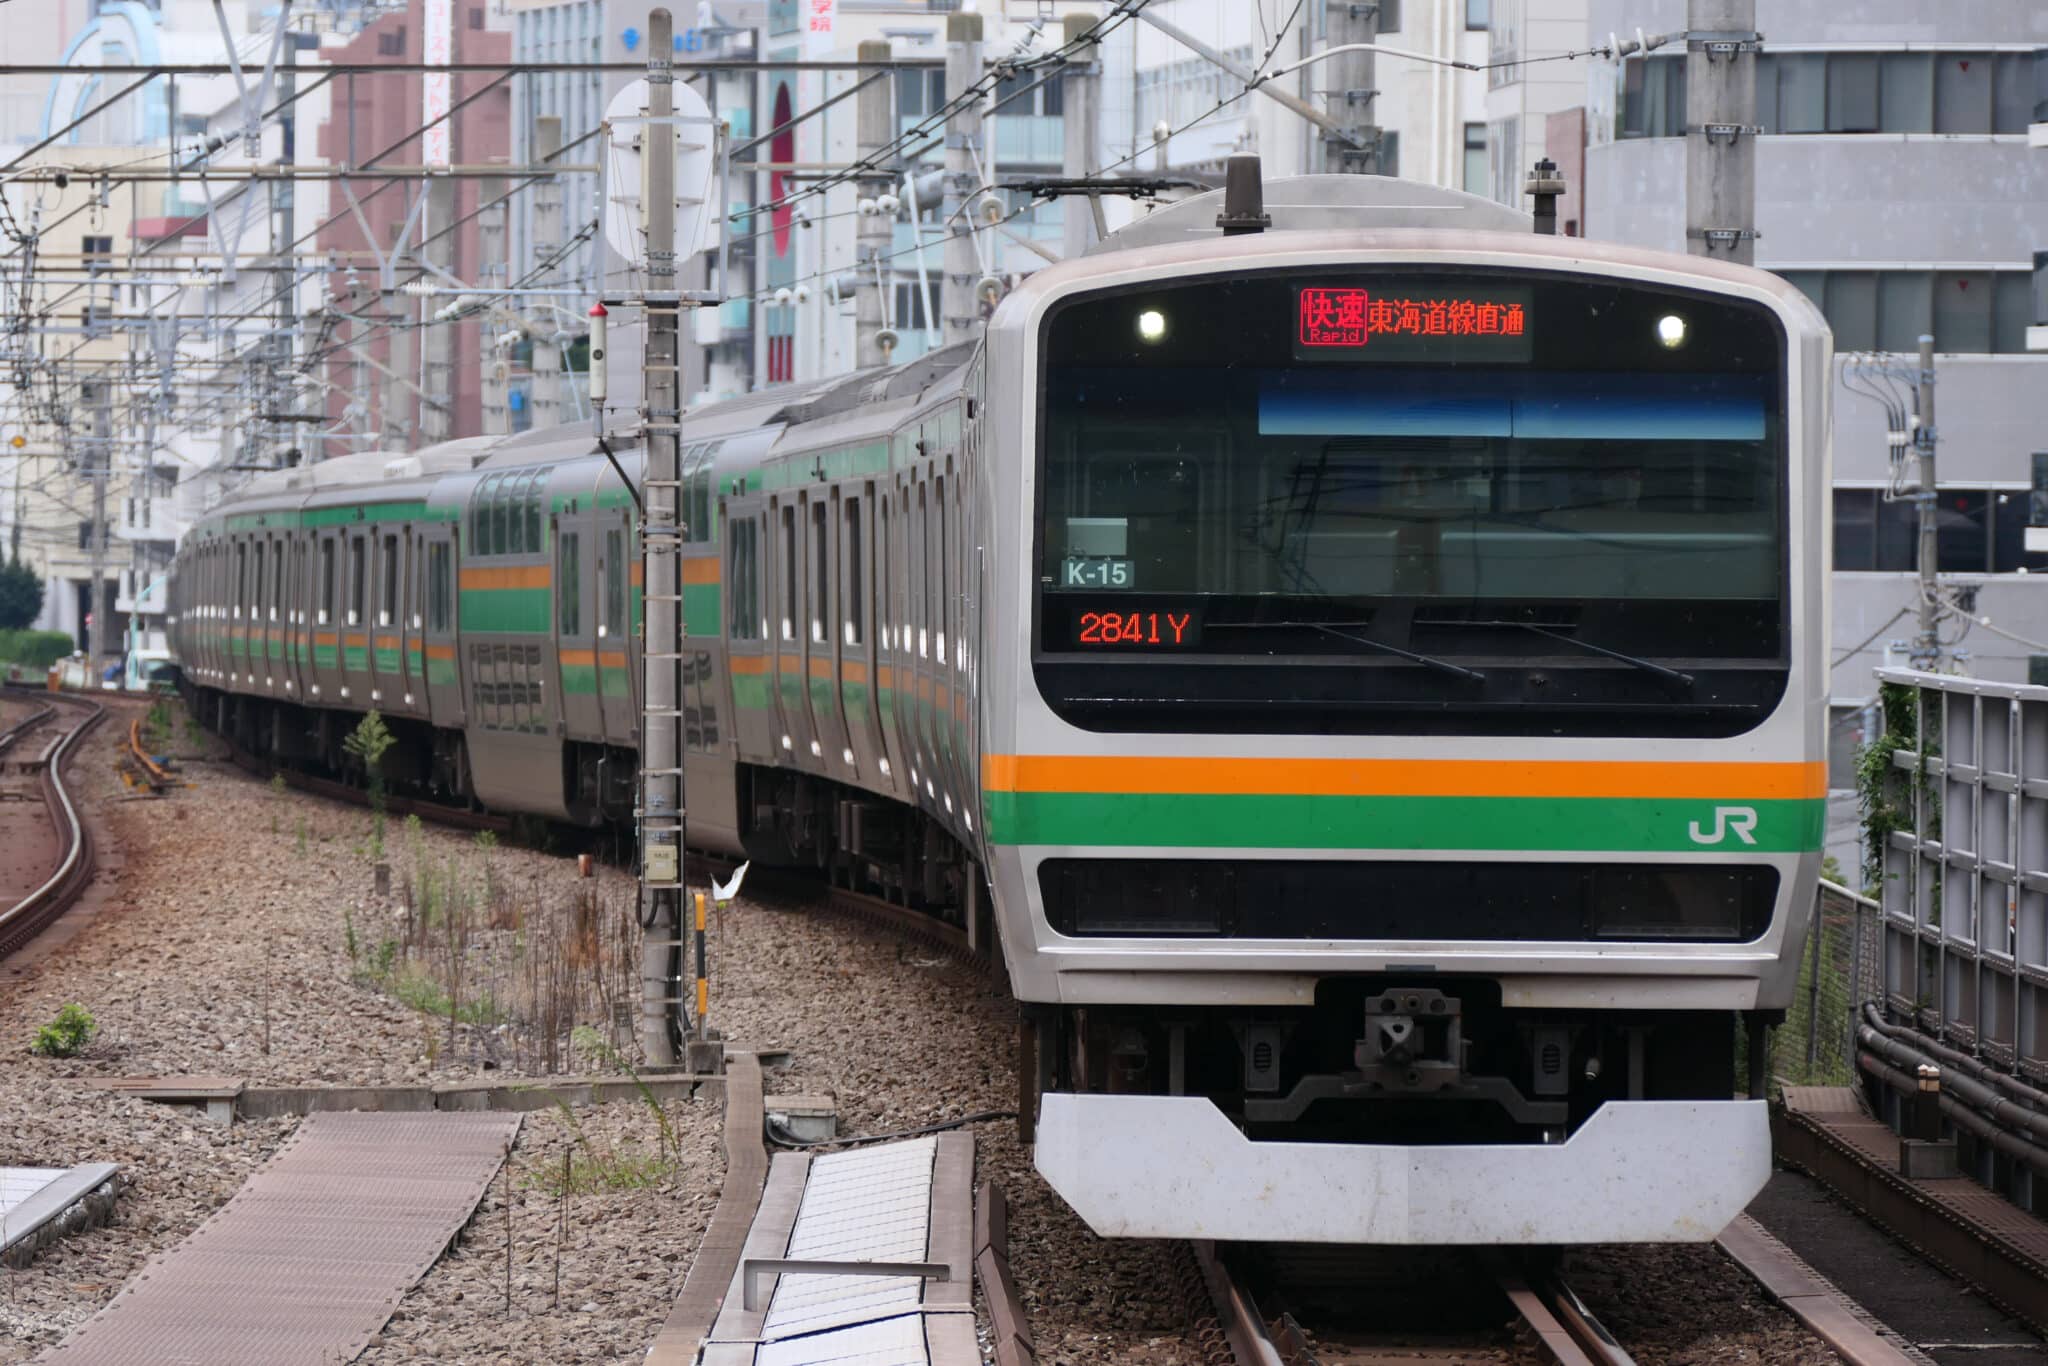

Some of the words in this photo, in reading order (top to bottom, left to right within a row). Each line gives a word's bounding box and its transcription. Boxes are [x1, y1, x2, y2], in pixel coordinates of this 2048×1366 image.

[1304, 291, 1364, 328] 快速
[1367, 299, 1525, 336] 東海道線直通
[1310, 329, 1360, 343] Rapid
[1068, 562, 1127, 585] K-15
[1079, 612, 1191, 644] 2841Y
[1689, 806, 1758, 845] JR
